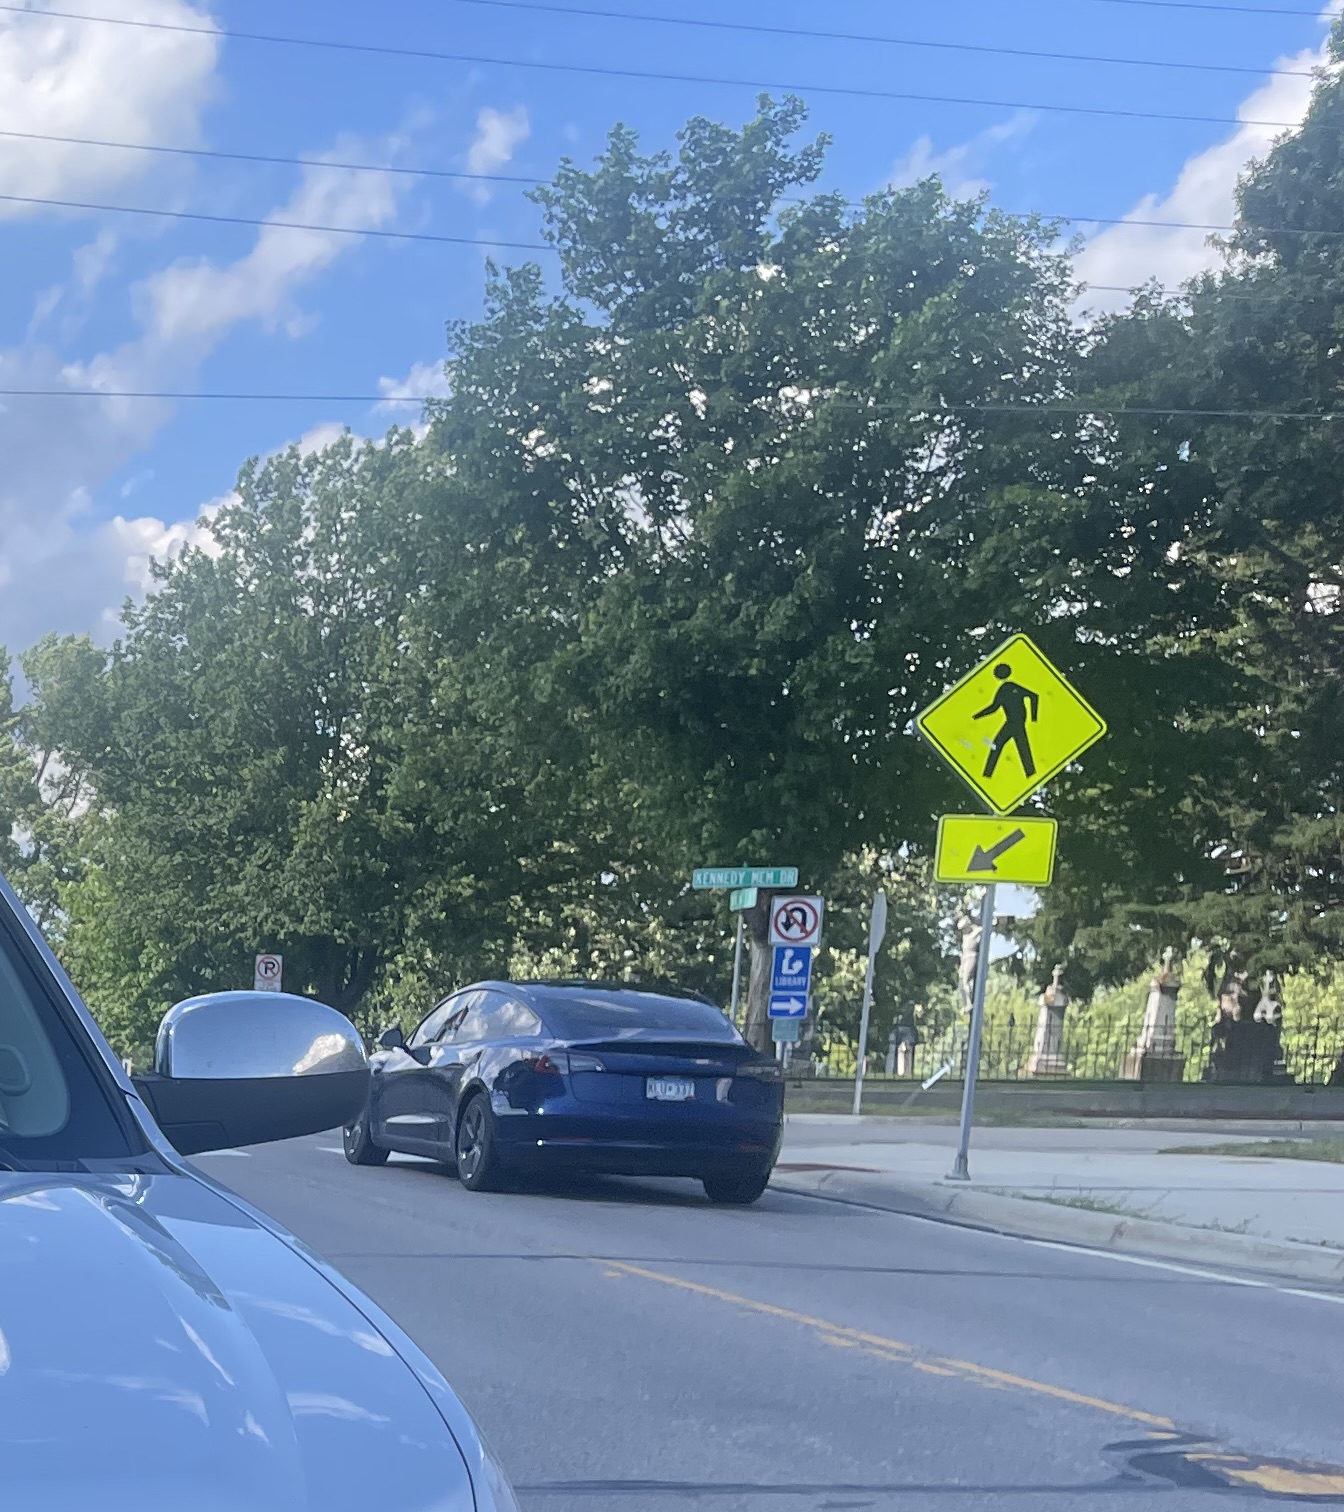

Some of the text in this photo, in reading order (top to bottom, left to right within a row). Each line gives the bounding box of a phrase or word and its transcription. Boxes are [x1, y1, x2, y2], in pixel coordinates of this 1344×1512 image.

[696, 869, 795, 885] KENNEDY MEM DR
[775, 976, 807, 987] LIBRARY
